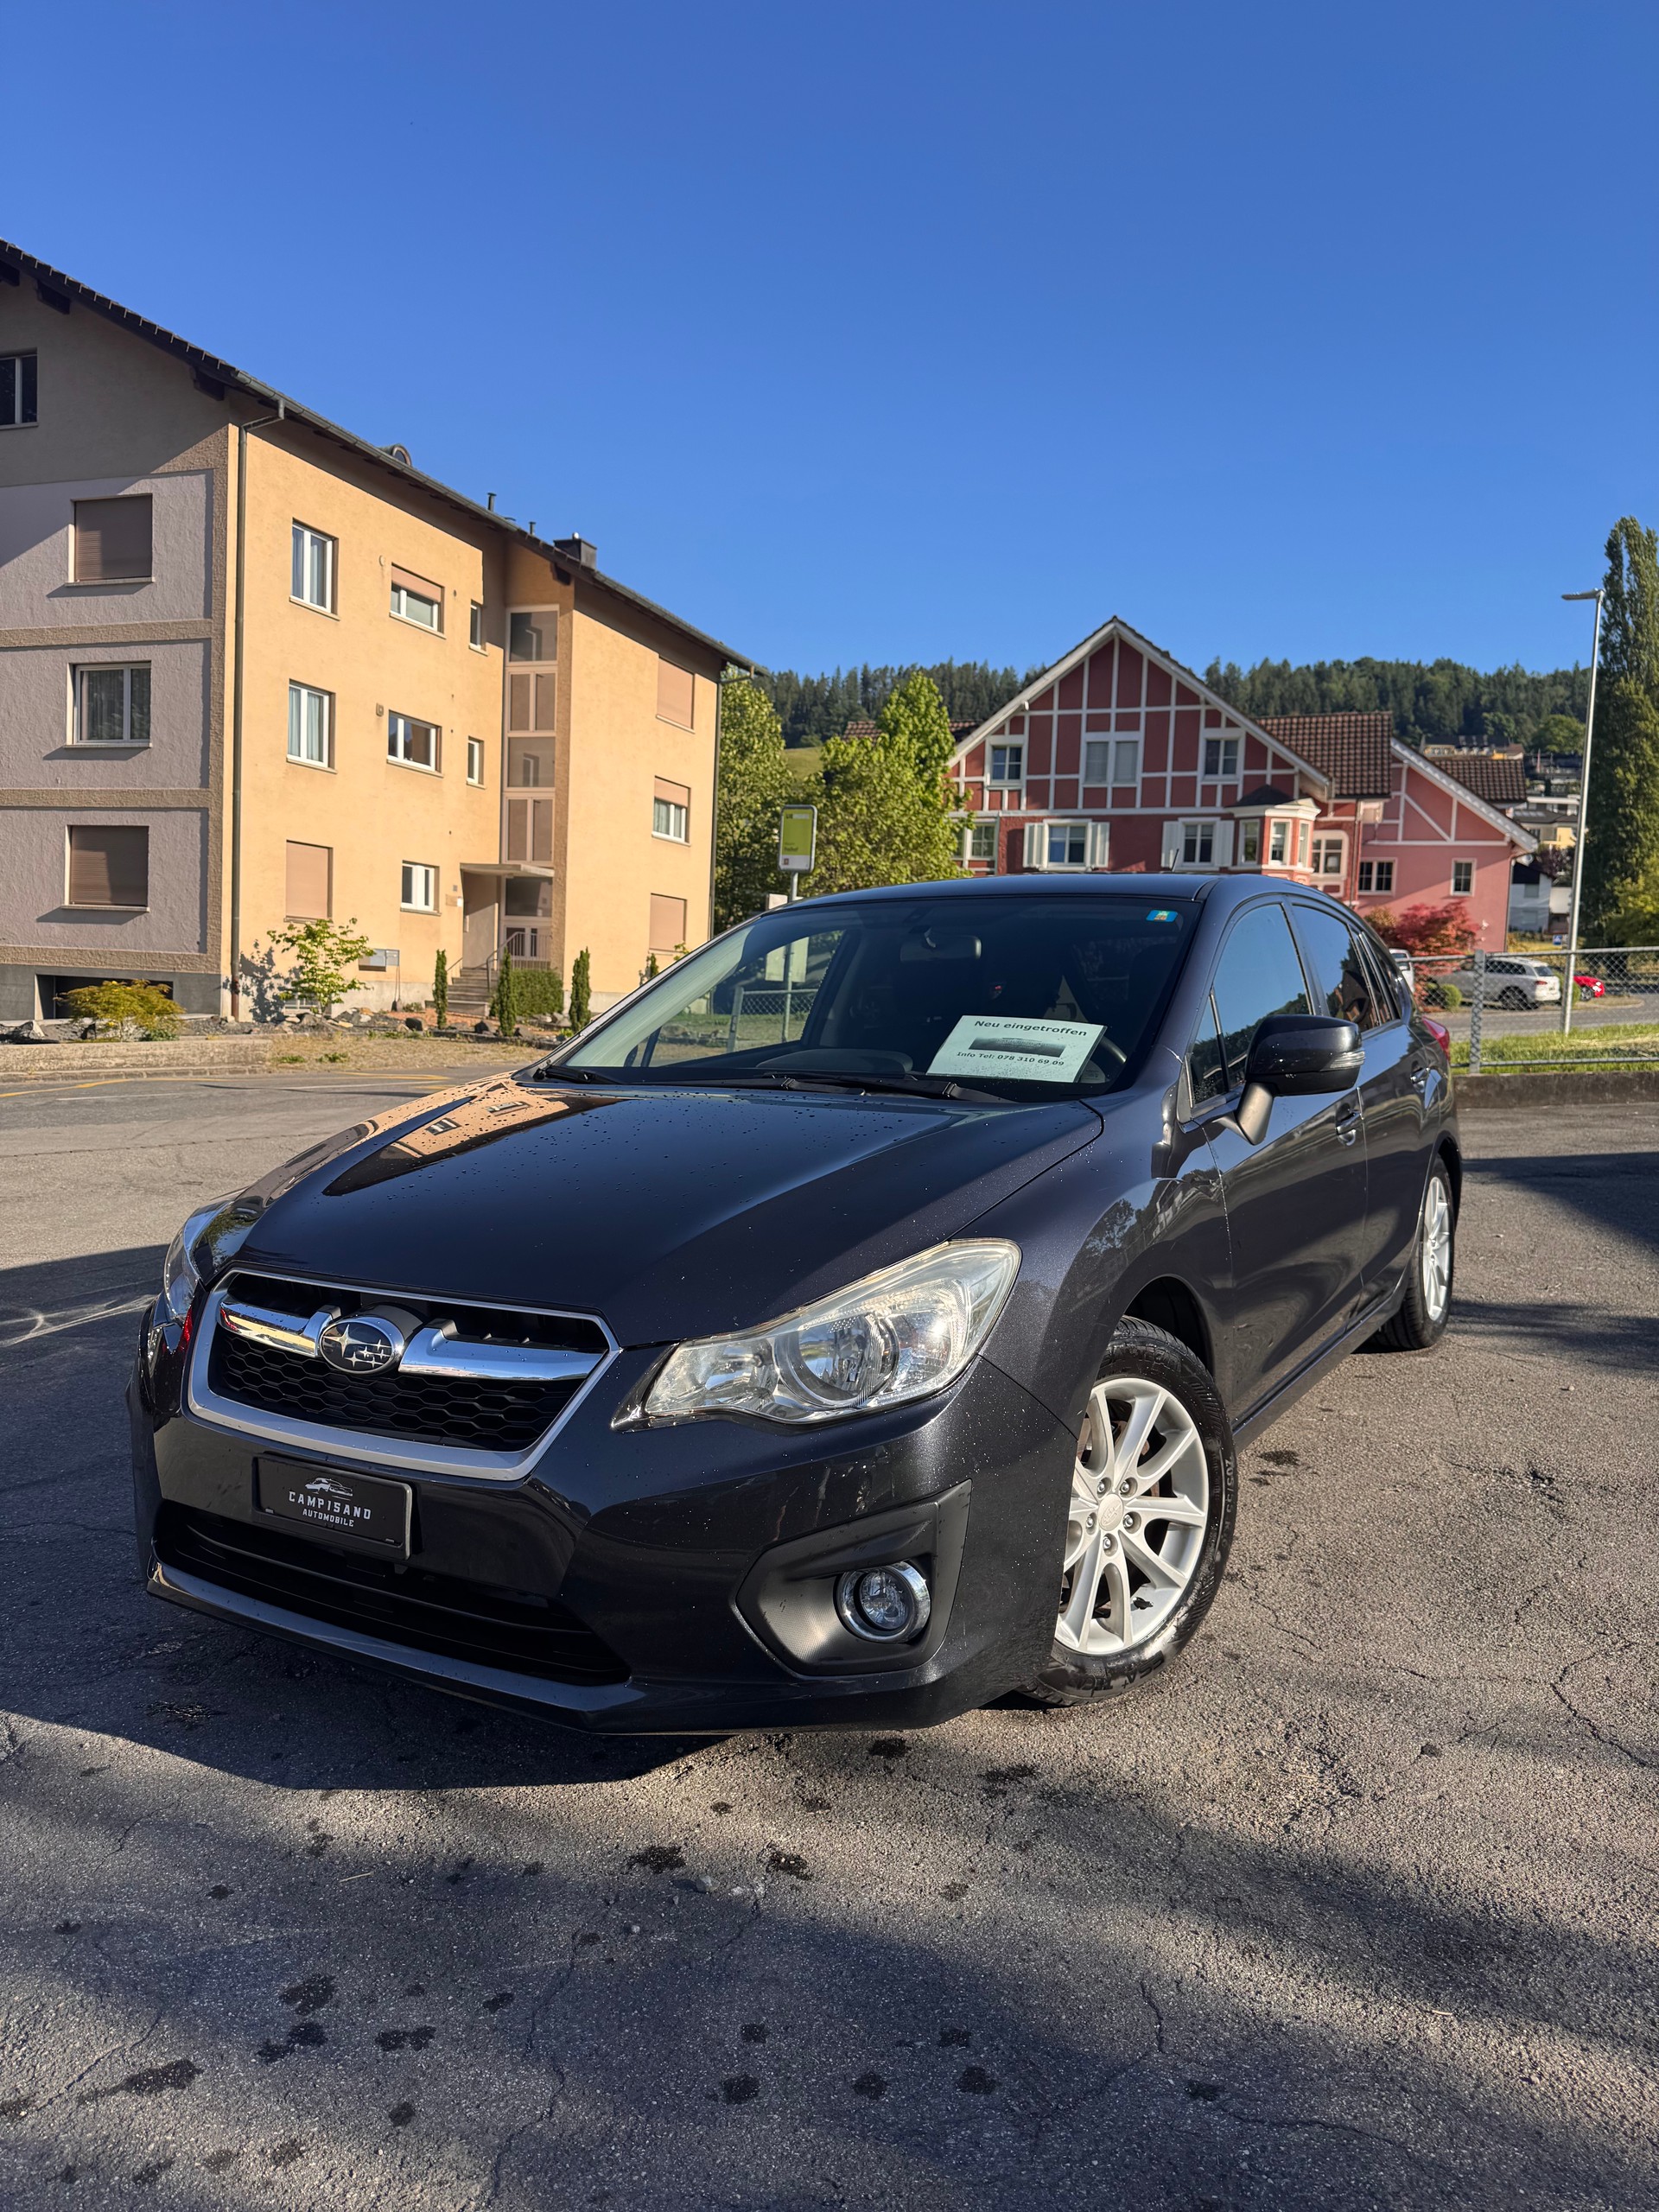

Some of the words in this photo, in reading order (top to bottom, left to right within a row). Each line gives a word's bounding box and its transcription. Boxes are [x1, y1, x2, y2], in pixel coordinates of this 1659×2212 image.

[1003, 1022, 1088, 1037] eingetroffen
[289, 1491, 372, 1520] CAMPISANO
[302, 1508, 354, 1528] AUTOMOBILE
